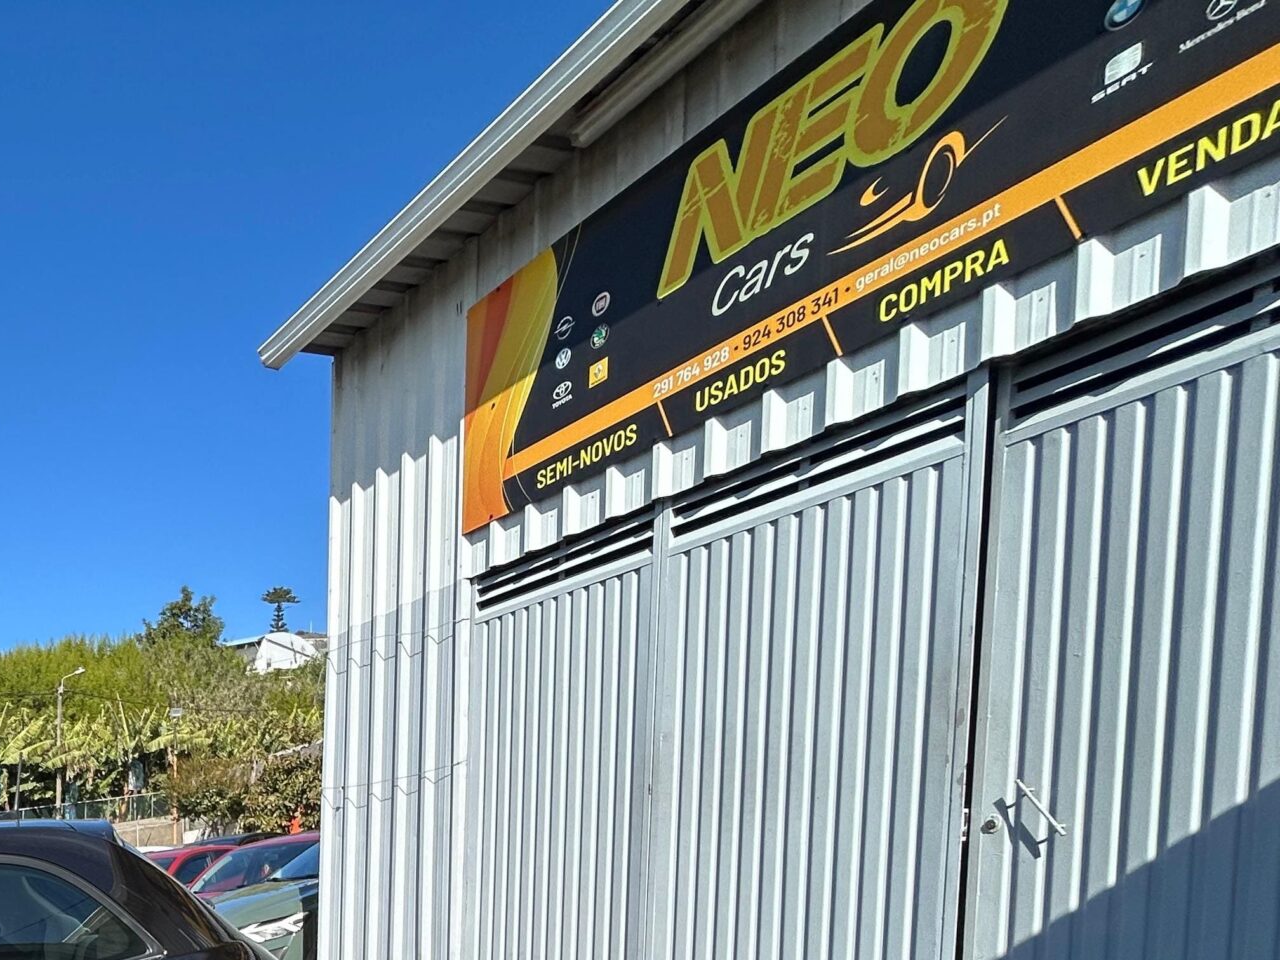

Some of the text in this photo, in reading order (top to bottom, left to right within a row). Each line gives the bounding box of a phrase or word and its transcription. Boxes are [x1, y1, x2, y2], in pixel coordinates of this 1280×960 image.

[1091, 62, 1154, 104] SEAT
[657, 0, 1009, 299] NEO
[1137, 99, 1280, 197] VENDA
[652, 203, 1002, 398] 291 764 928 924 308 341 geral@neocars.pt
[712, 232, 814, 316] Cars
[879, 238, 1010, 323] COMPRA
[551, 393, 573, 410] TOYOTA
[695, 349, 786, 412] USADOS
[536, 423, 637, 489] SEMI-NOVOS
